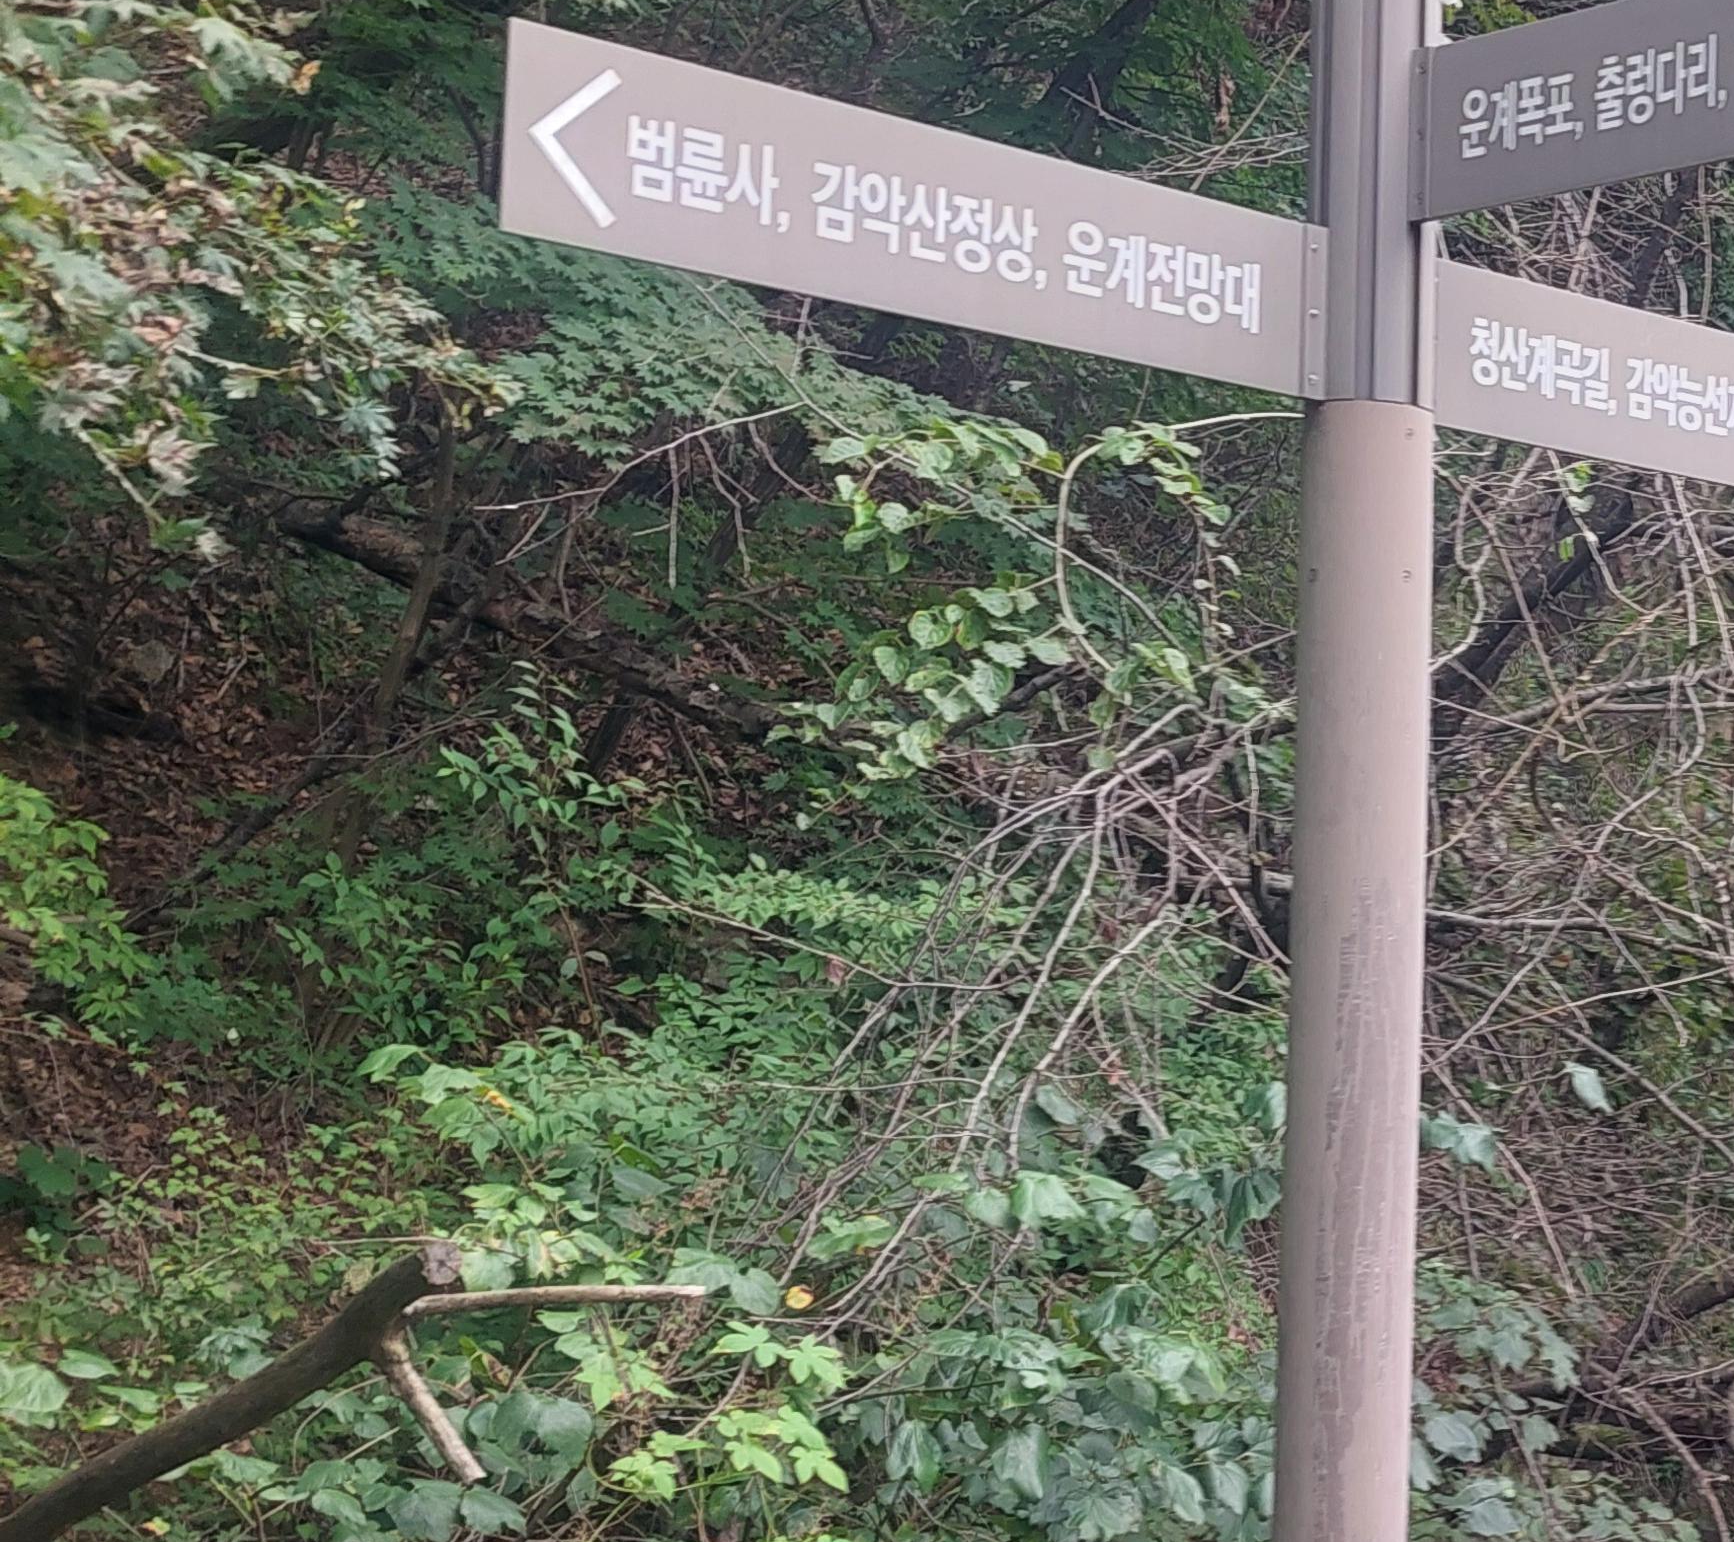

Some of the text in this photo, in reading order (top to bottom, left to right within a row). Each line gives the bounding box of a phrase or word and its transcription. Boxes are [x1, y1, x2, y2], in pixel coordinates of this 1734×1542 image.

[1458, 72, 1584, 159] 운계폭포,
[1594, 33, 1728, 131] 출렁다리,
[626, 114, 1263, 334] 범륜사, 감악산정상, 운계전망대
[1469, 316, 1617, 416] 청산계곡길,
